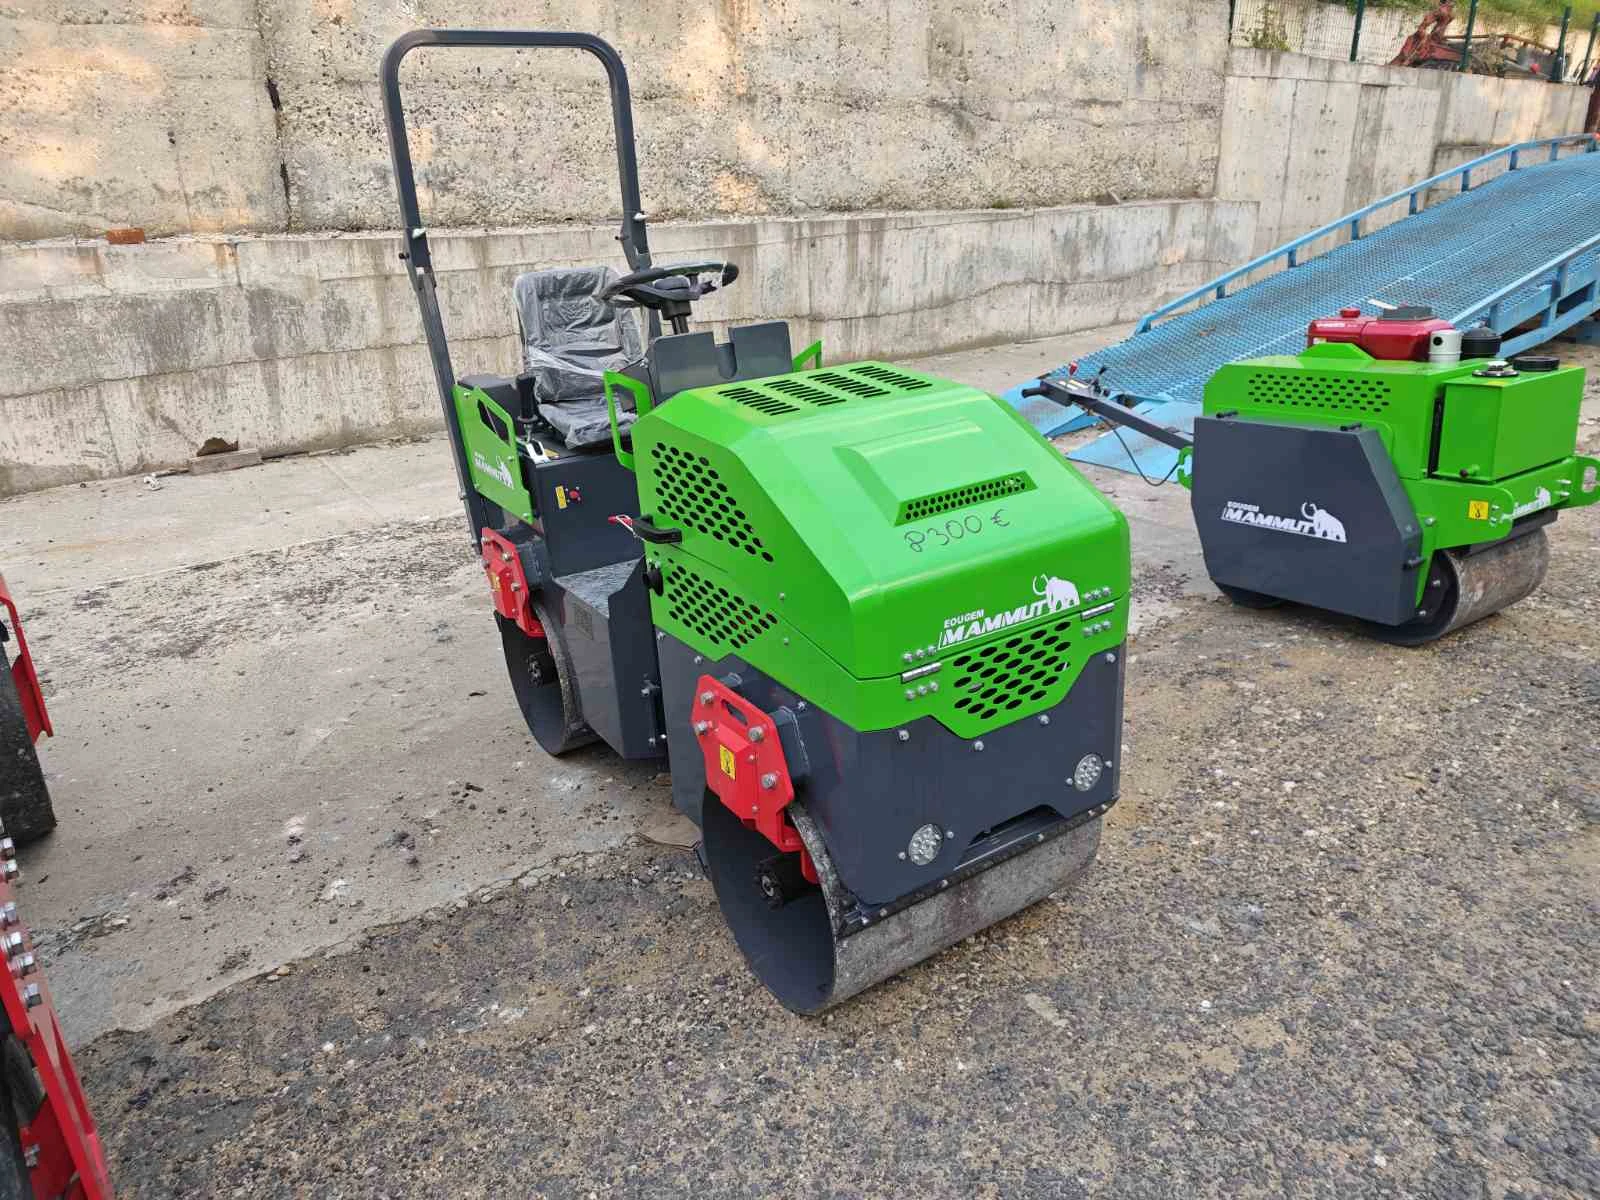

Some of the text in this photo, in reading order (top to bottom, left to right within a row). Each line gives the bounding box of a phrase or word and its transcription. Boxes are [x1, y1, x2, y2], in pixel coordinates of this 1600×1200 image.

[990, 508, 1011, 528] €
[1225, 508, 1314, 533] MAMMUT
[942, 600, 1048, 645] MAMMUT
